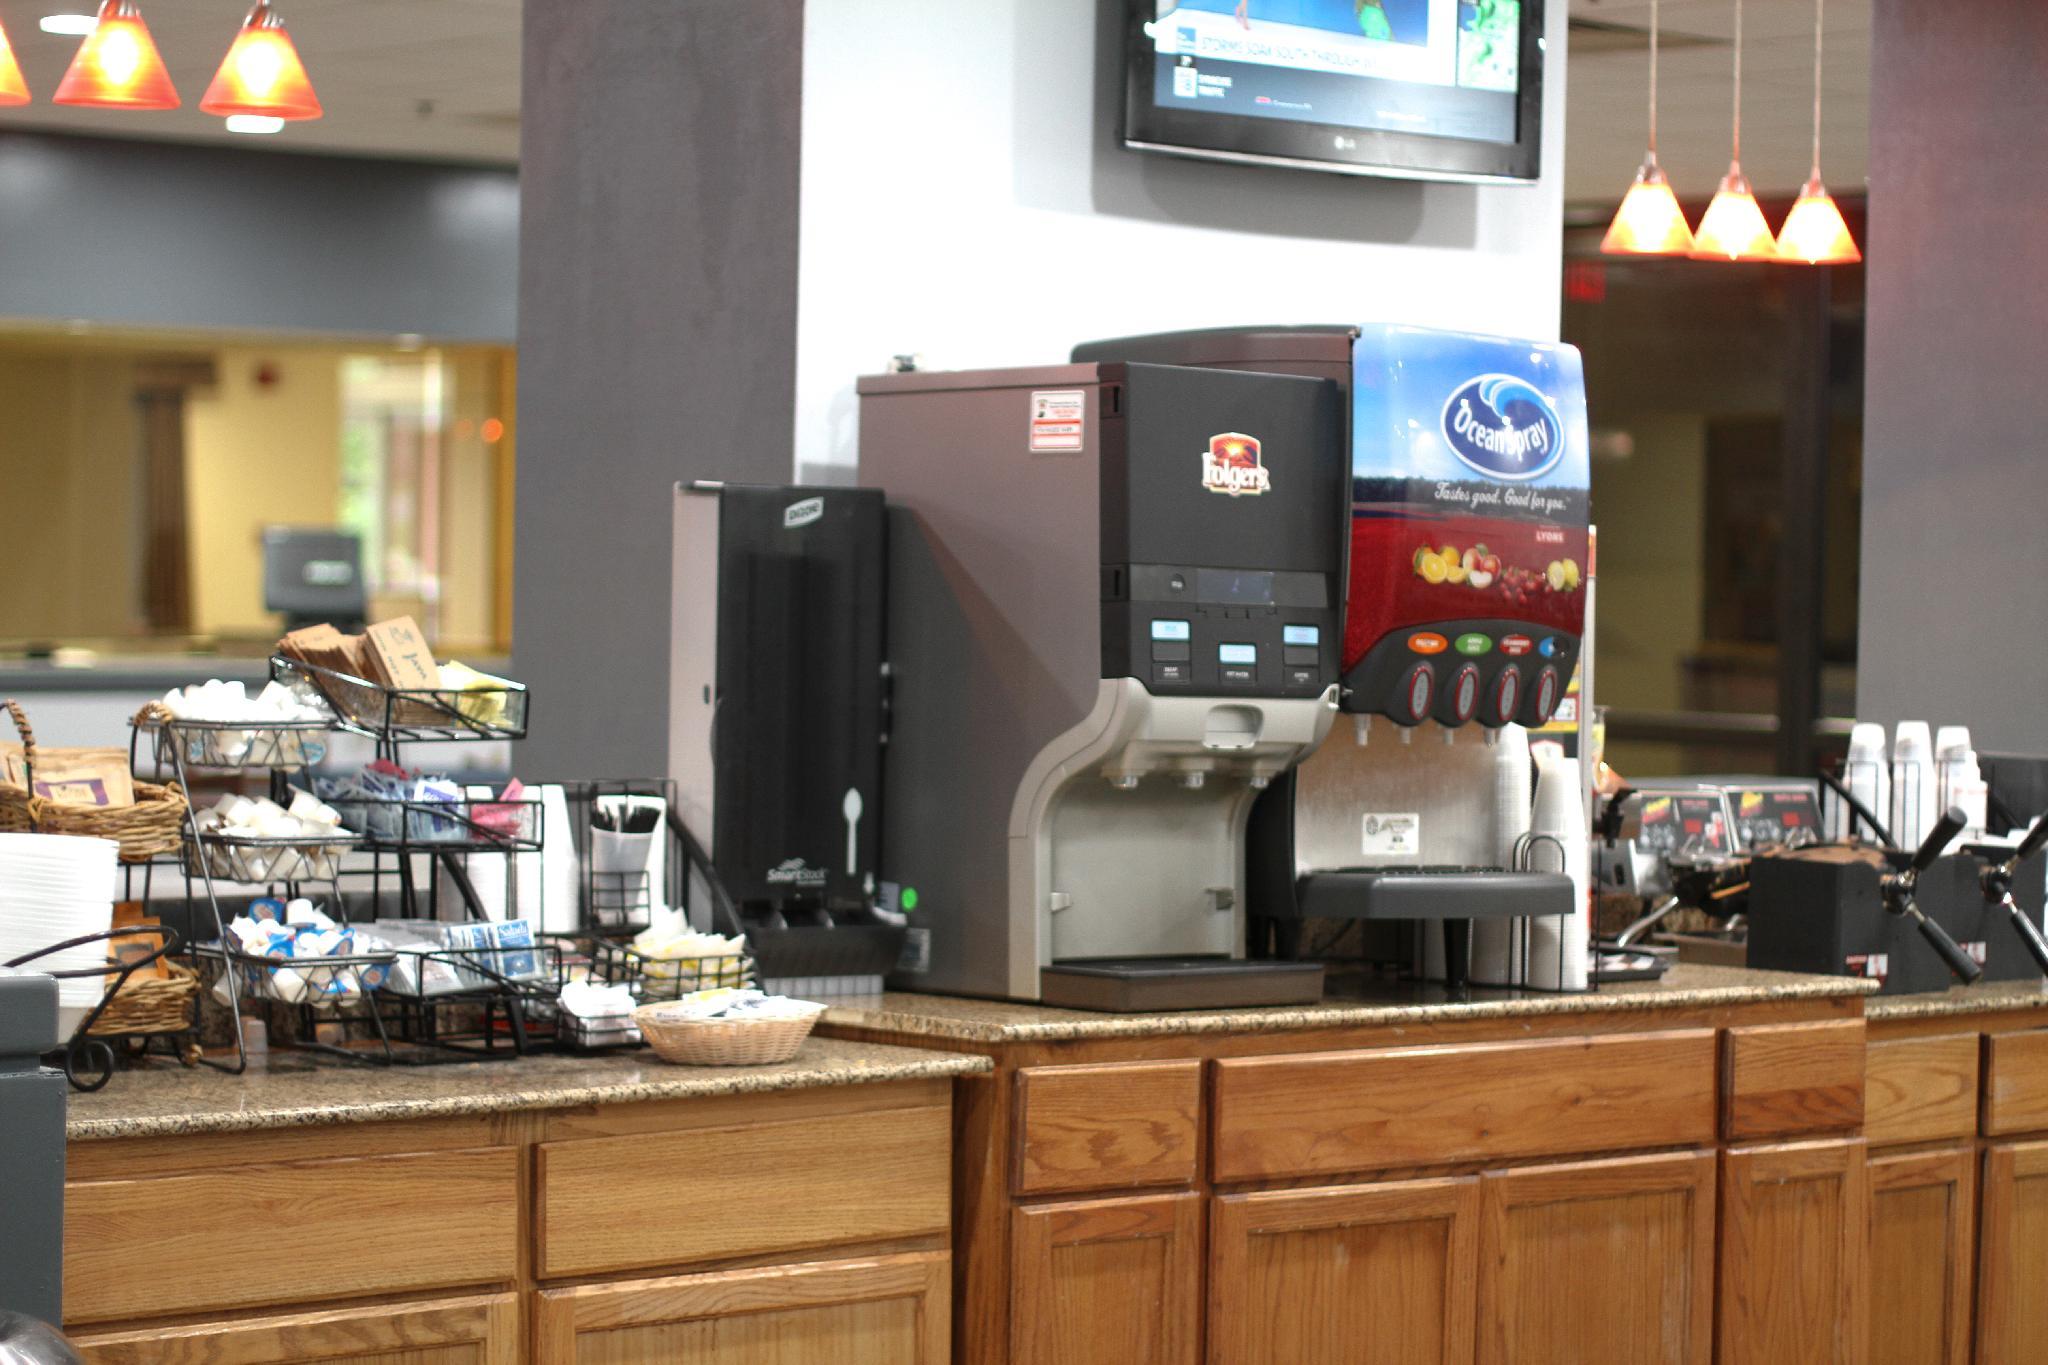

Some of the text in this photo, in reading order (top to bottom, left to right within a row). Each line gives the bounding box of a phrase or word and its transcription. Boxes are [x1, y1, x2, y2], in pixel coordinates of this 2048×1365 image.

[1202, 452, 1269, 496] Folgers
[1434, 482, 1566, 515] Tastes good. Good for you.
[1536, 530, 1564, 543] LYONS
